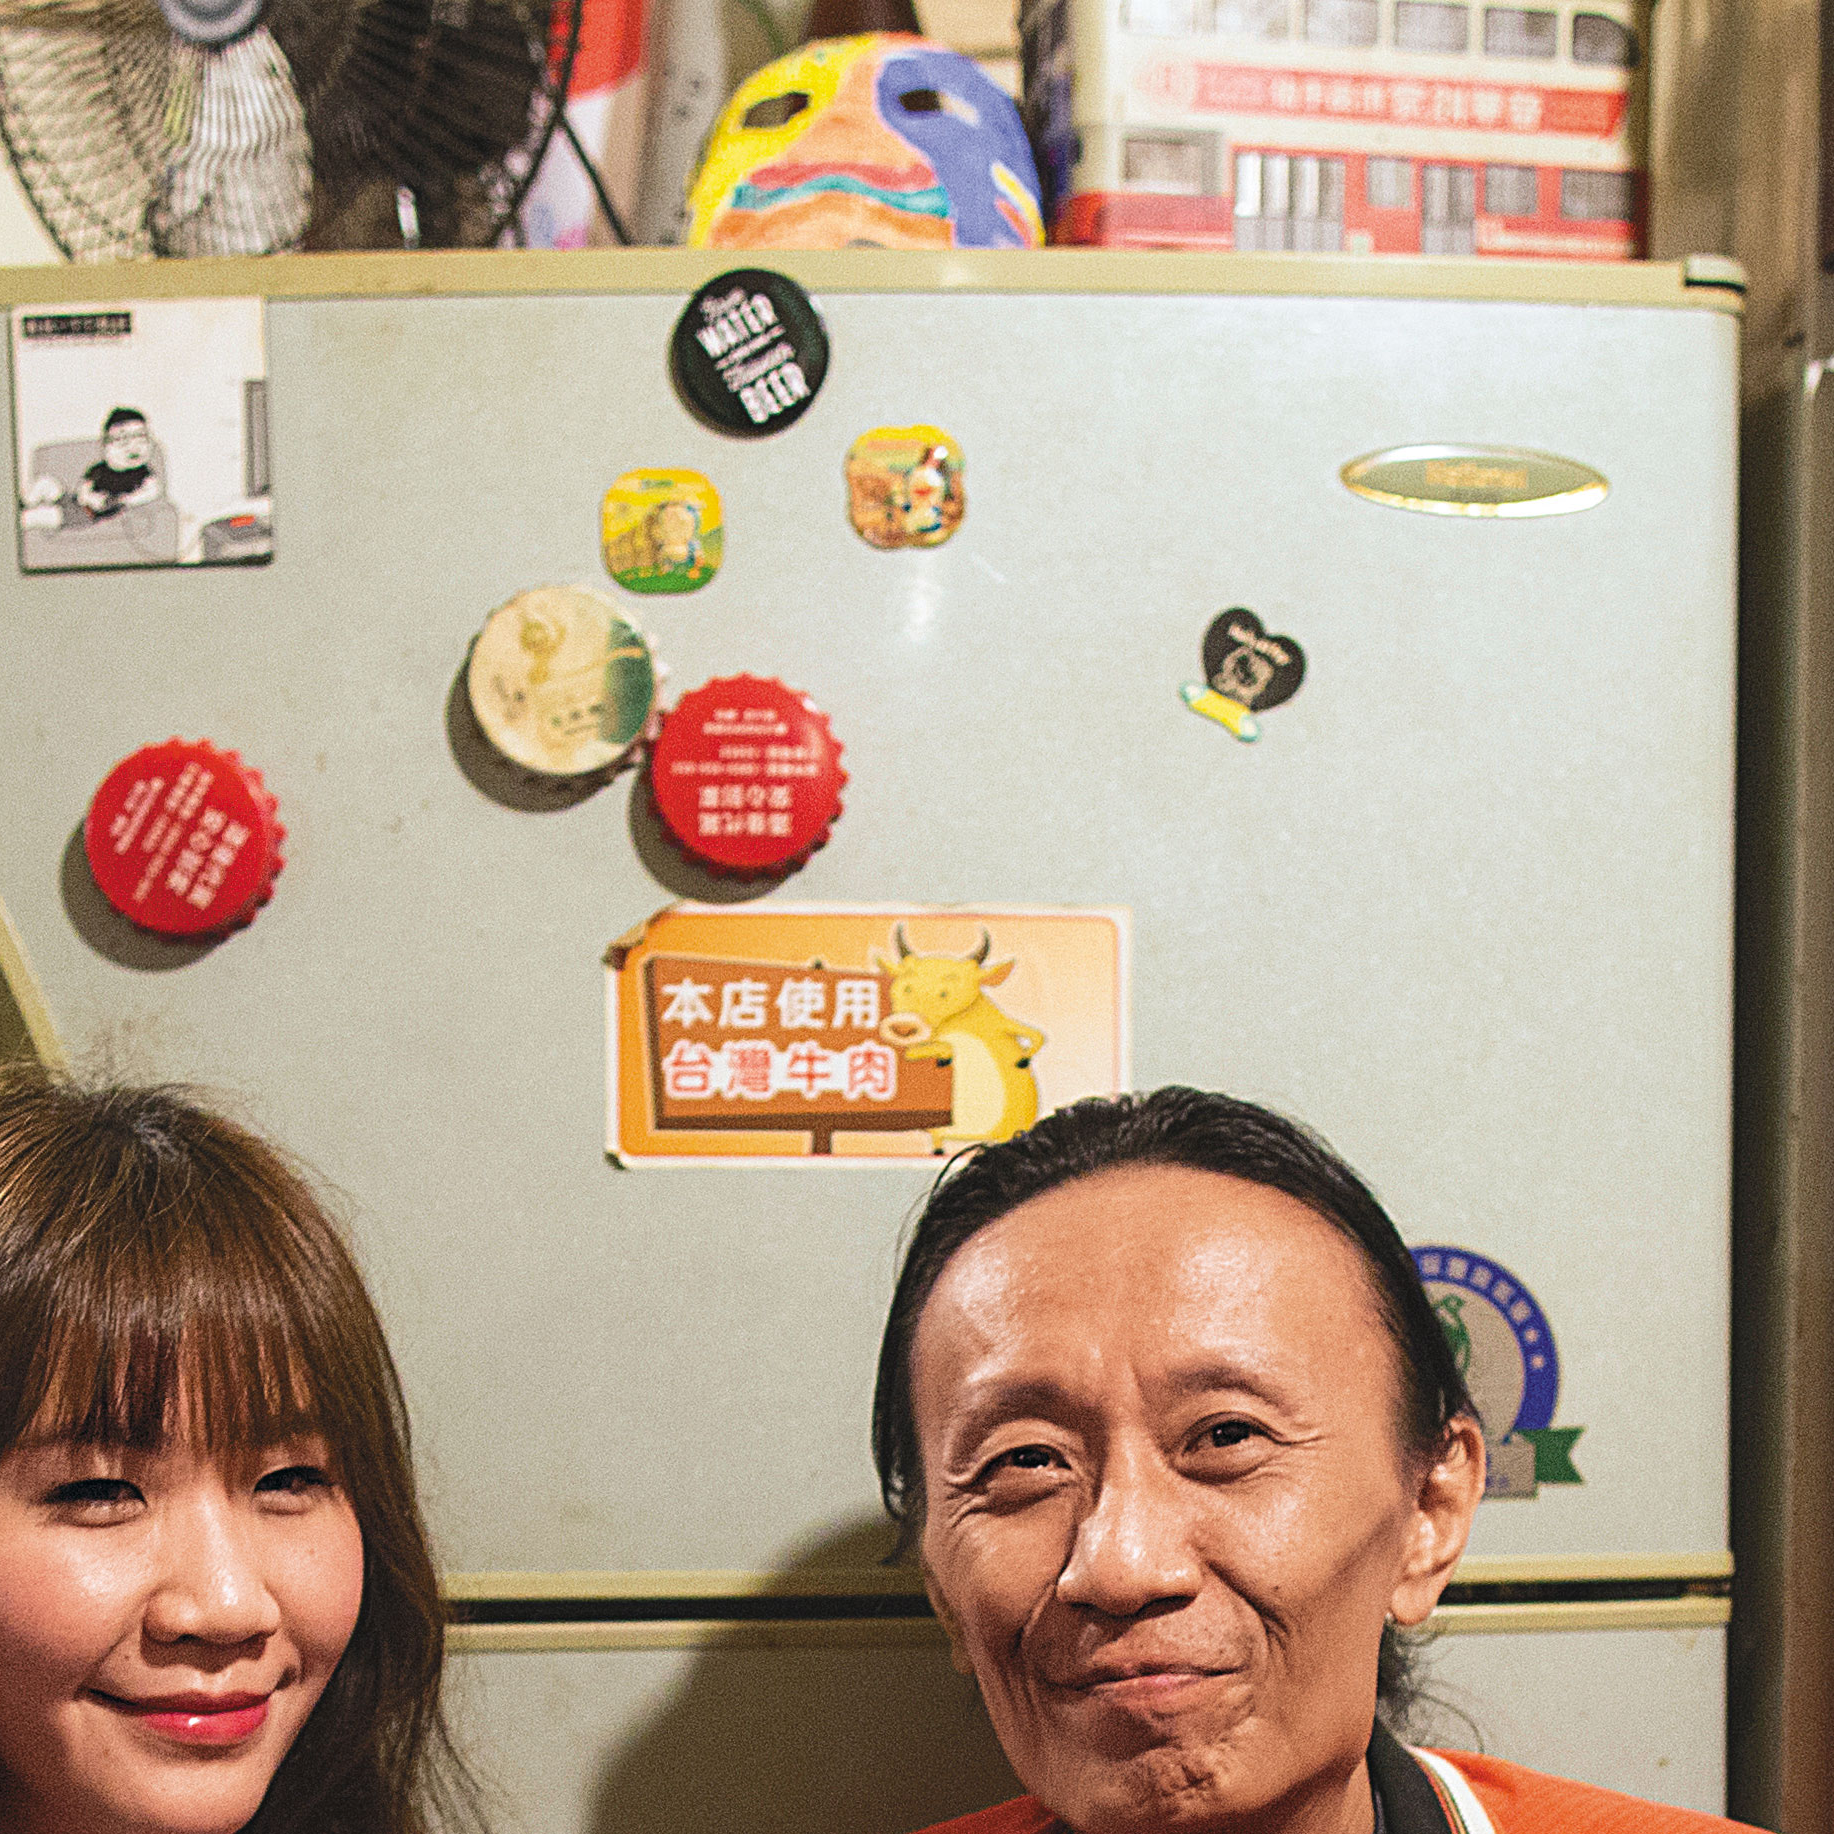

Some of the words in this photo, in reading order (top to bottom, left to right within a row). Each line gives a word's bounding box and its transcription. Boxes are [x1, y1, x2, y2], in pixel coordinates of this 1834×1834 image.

[739, 362, 811, 423] BEER
[662, 977, 881, 1030] 本店使用
[664, 1040, 897, 1100] 台灣牛肉
